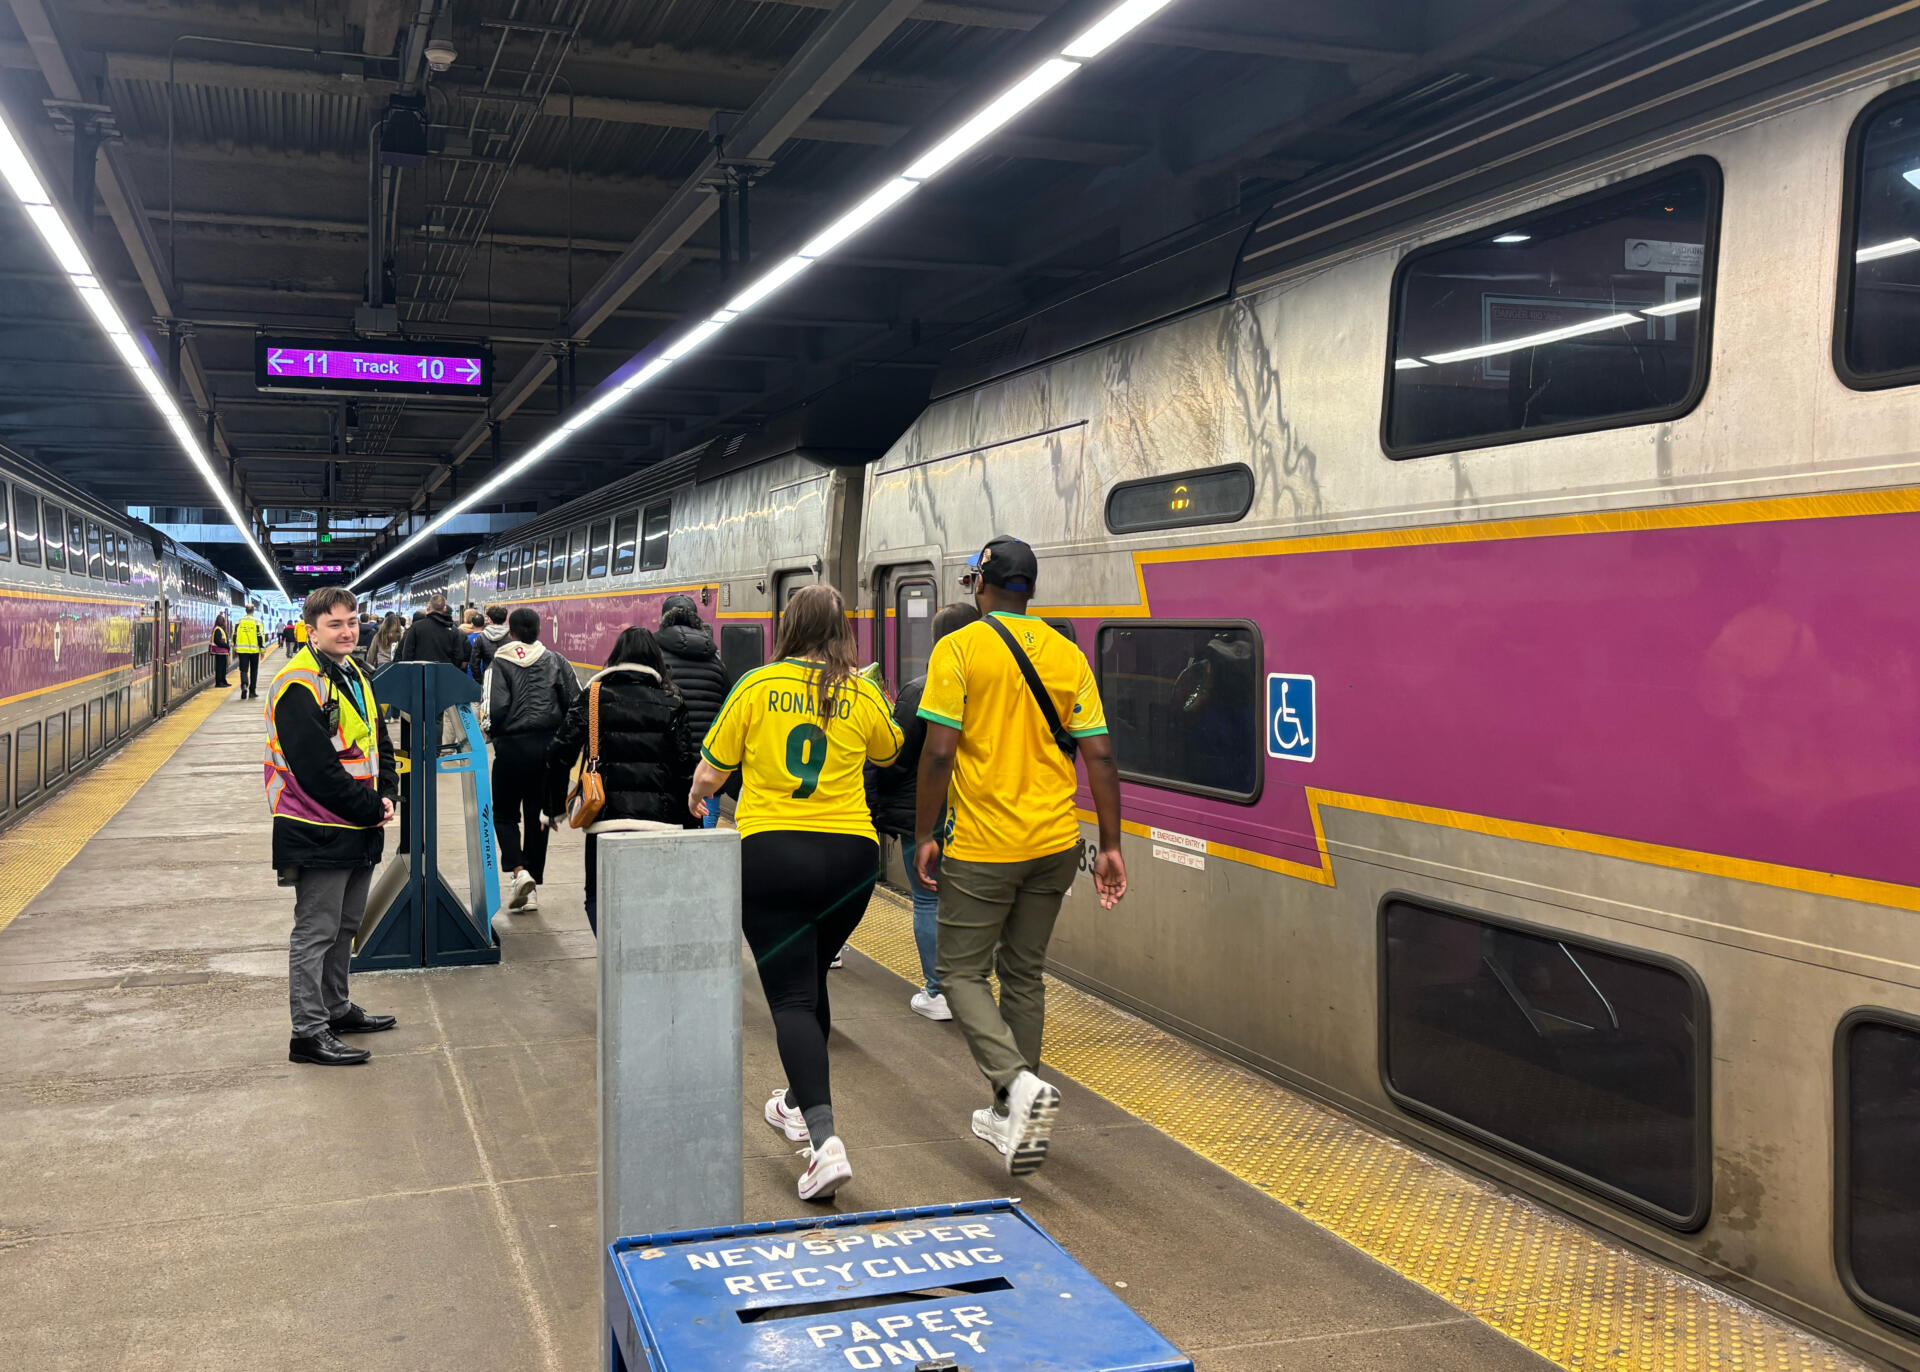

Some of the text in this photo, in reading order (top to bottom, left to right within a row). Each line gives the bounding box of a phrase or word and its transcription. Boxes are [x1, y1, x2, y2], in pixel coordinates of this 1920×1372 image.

[303, 352, 444, 380] 11 Track 10
[515, 646, 526, 659] B
[785, 723, 828, 799] 9
[482, 821, 492, 868] AMTRAK
[1157, 830, 1201, 849] EMERGENCY ENTRY
[686, 1223, 996, 1271] NEWSPAPER
[723, 1246, 1004, 1296] RECYCLING
[806, 1305, 994, 1349] PAPER
[843, 1331, 987, 1371] ONLY
